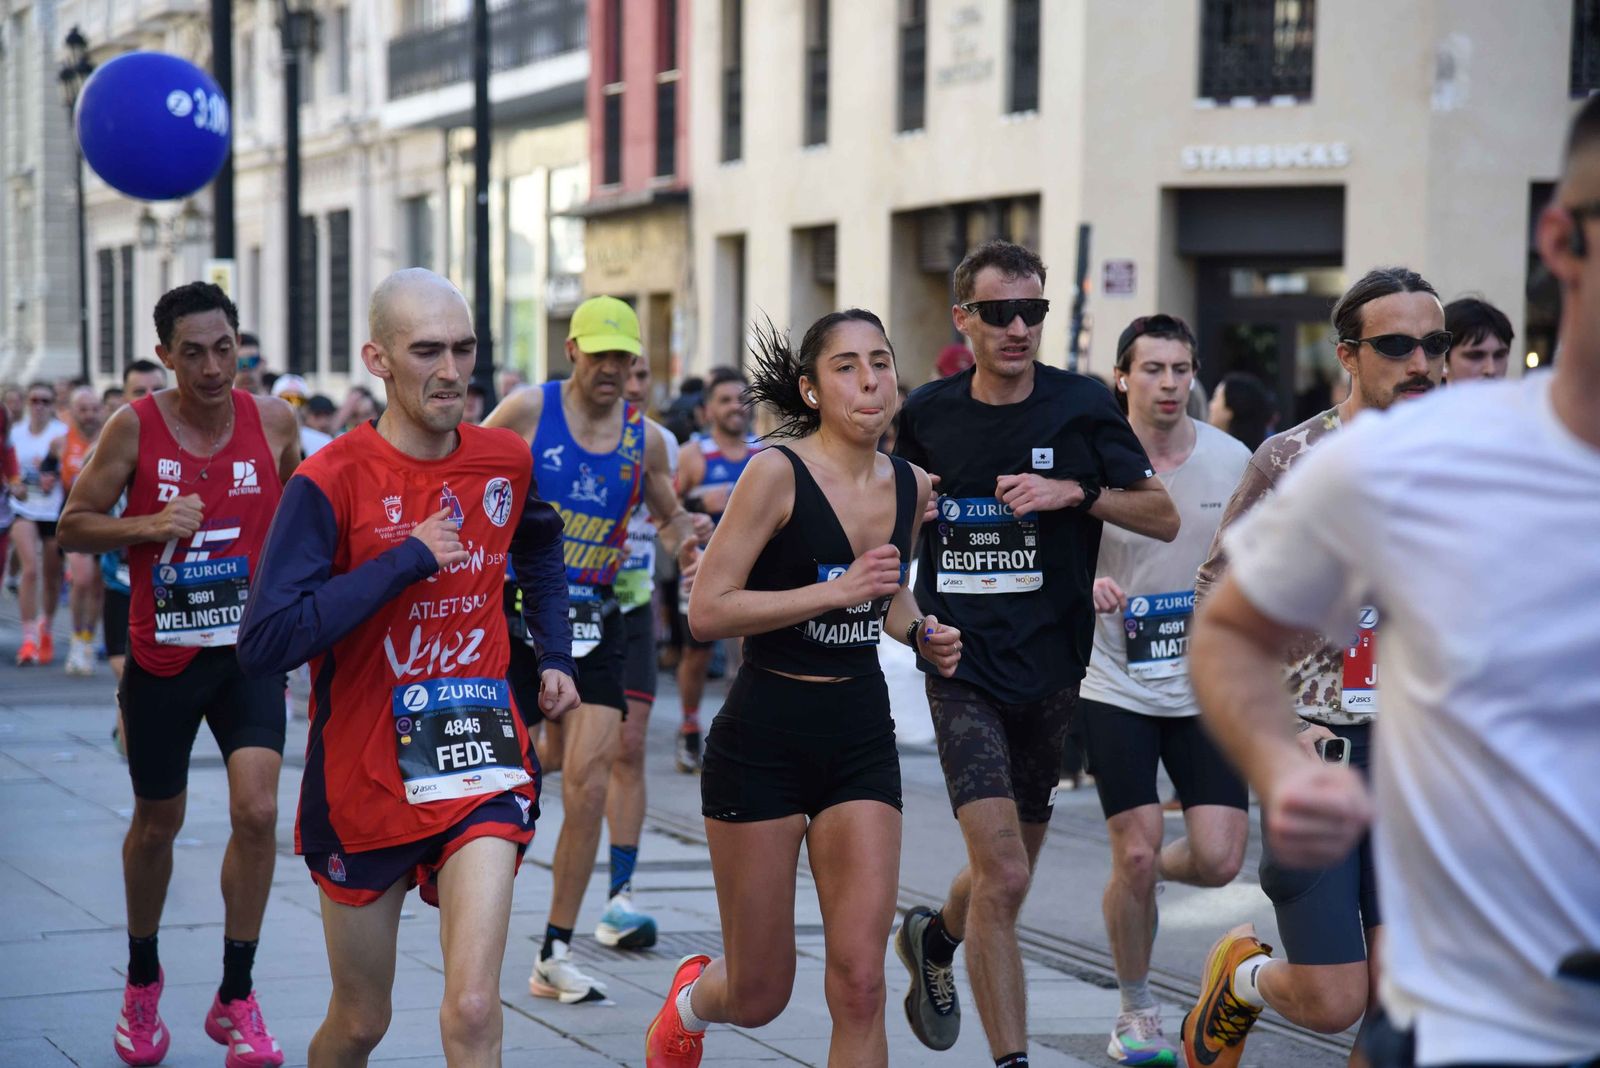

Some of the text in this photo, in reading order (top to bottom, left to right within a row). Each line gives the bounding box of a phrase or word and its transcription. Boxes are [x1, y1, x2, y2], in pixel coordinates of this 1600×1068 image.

[1181, 143, 1349, 170] STARBUCKS
[967, 504, 1013, 516] ZURIC
[969, 533, 1001, 545] 3896
[942, 550, 1037, 571] GEOFFROY
[183, 562, 237, 579] ZURICH
[187, 590, 215, 605] 3691
[1155, 595, 1195, 610] ZURIC
[1159, 621, 1185, 635] 4591
[438, 684, 497, 701] ZURICH
[444, 718, 481, 736] 4845
[436, 741, 497, 771] FEDE
